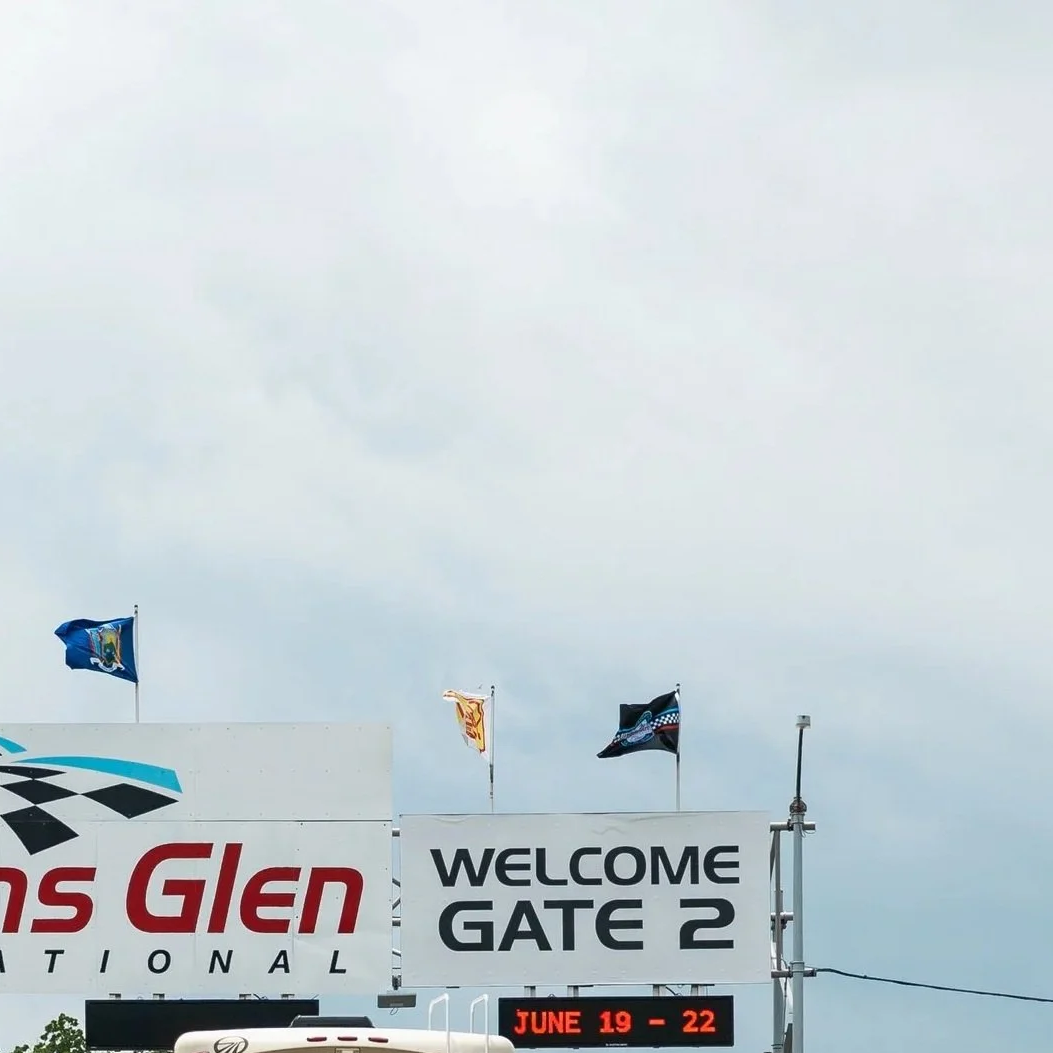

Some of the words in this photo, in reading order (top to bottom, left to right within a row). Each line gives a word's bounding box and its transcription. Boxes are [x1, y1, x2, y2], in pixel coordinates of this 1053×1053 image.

[127, 843, 363, 933] Glen
[430, 846, 740, 886] WELCOME
[438, 899, 644, 951] GATE
[679, 899, 734, 949] 2
[514, 1009, 582, 1035] JUNE
[599, 1010, 633, 1034] 19
[682, 1008, 716, 1034] 22
